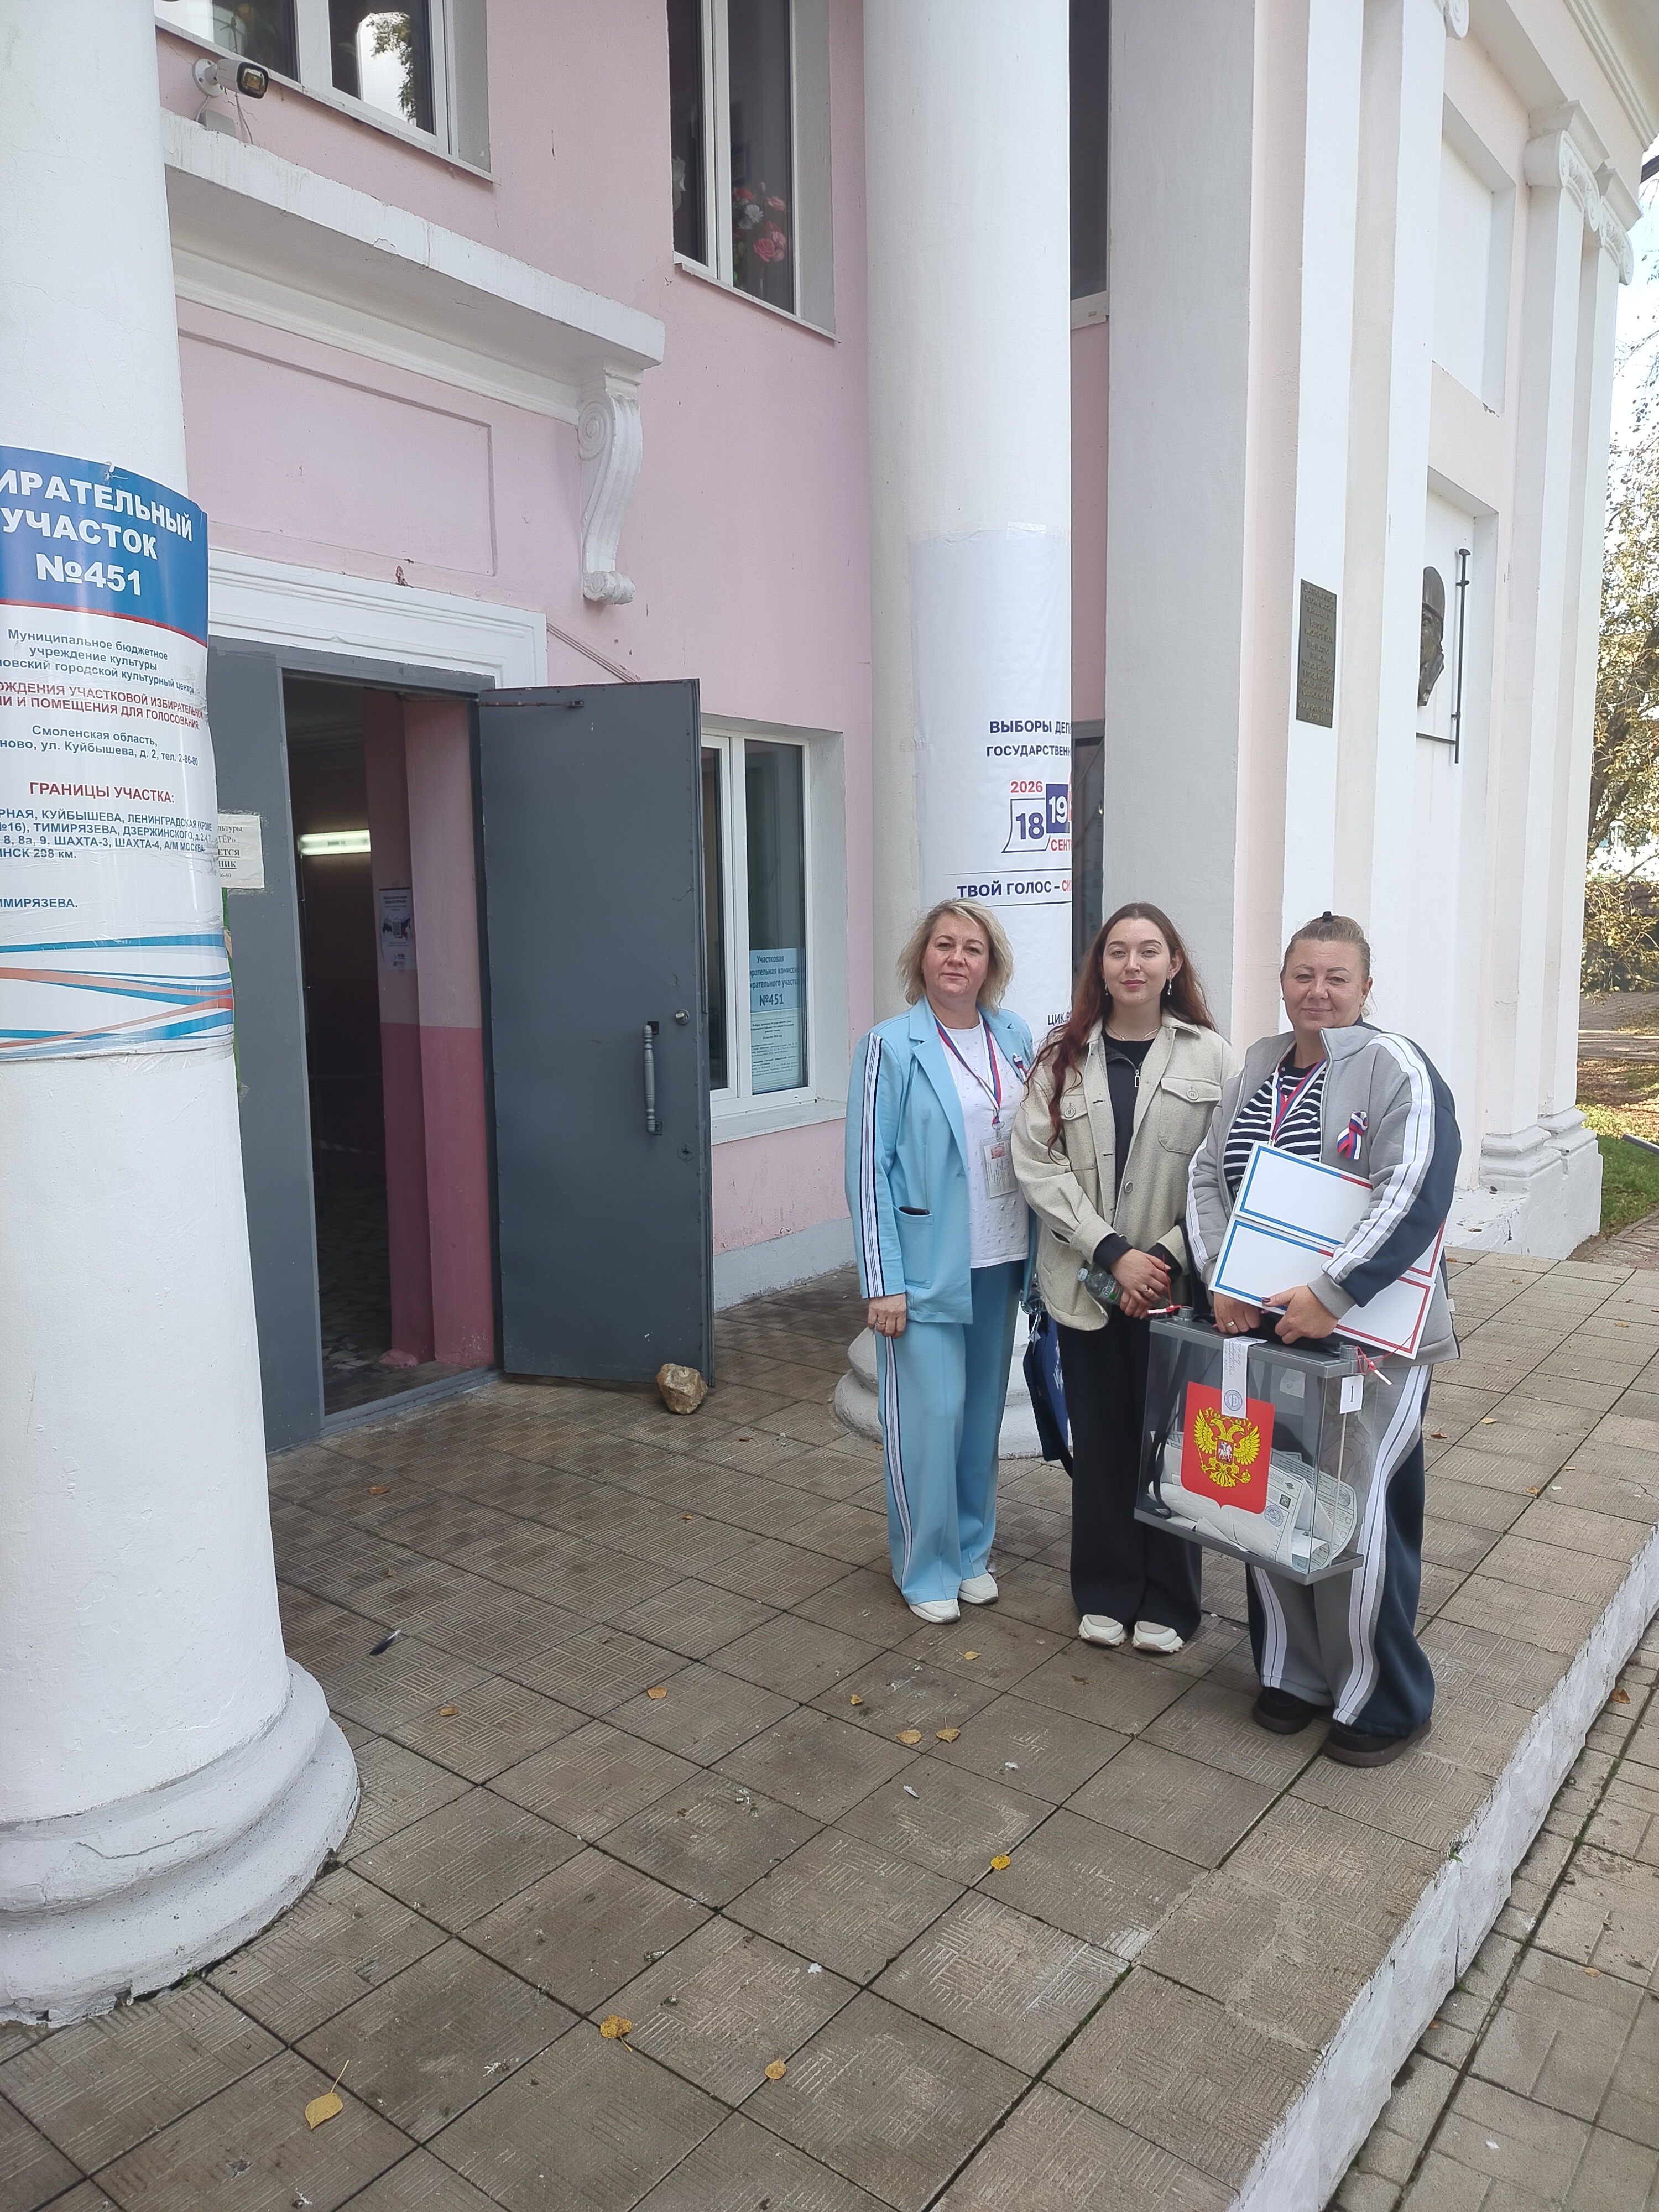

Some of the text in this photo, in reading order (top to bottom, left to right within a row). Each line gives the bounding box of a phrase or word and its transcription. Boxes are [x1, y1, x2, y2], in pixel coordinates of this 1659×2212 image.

[0, 469, 192, 541] ИРАТЕЛЬНЫЙ
[0, 507, 157, 560] УЧАСТОК
[36, 553, 140, 596] №451
[8, 629, 168, 660] Муниципальное бюджетное
[29, 647, 157, 670] учреждение культуры
[0, 659, 50, 670] овский
[55, 663, 118, 677] городской
[122, 671, 174, 687] культурный
[0, 696, 200, 730] И И ПОМЕЩЕНИЯ ДЛЯ ГОЛОСОВАНИЯ:
[69, 687, 148, 705] УЧАСТКОВОЙ
[150, 697, 202, 719] ИЗБИРАТЕЛЬНОЙ
[32, 725, 158, 747] Смоленская область,
[990, 720, 1071, 735] ВЫБОРЫ ДЕП
[0, 740, 198, 766] ново, ул. Куйбышева, д. 2, тел. 2-86-80
[30, 782, 174, 803] ГРАНИЦЫ УЧАСТКА:
[1010, 781, 1043, 793] 2026
[42, 808, 124, 823] КУЙБЫШЕВА,
[128, 814, 196, 828] ЛЕНИНГРАДСКАЯ
[1048, 796, 1068, 823] 19
[33, 823, 119, 836] ТИМИРЯЗЕВА,
[123, 826, 194, 841] ДЗЕРЖИНСКОГО,
[1015, 812, 1044, 840] 18
[0, 848, 30, 858] НСК
[33, 849, 54, 858] 298
[4, 835, 14, 846] 8,
[18, 836, 35, 846] 8а,
[40, 836, 50, 847] 9,
[54, 836, 111, 848] ШАХТА-3,
[115, 838, 161, 851] ШАХТА-4,
[1051, 839, 1071, 851] СЕНТ
[957, 880, 1001, 898] ТВОЙ
[1006, 881, 1051, 895] ГОЛОС
[757, 955, 784, 963] Участковая
[759, 993, 784, 1006] №451
[1350, 1385, 1354, 1402] 1
